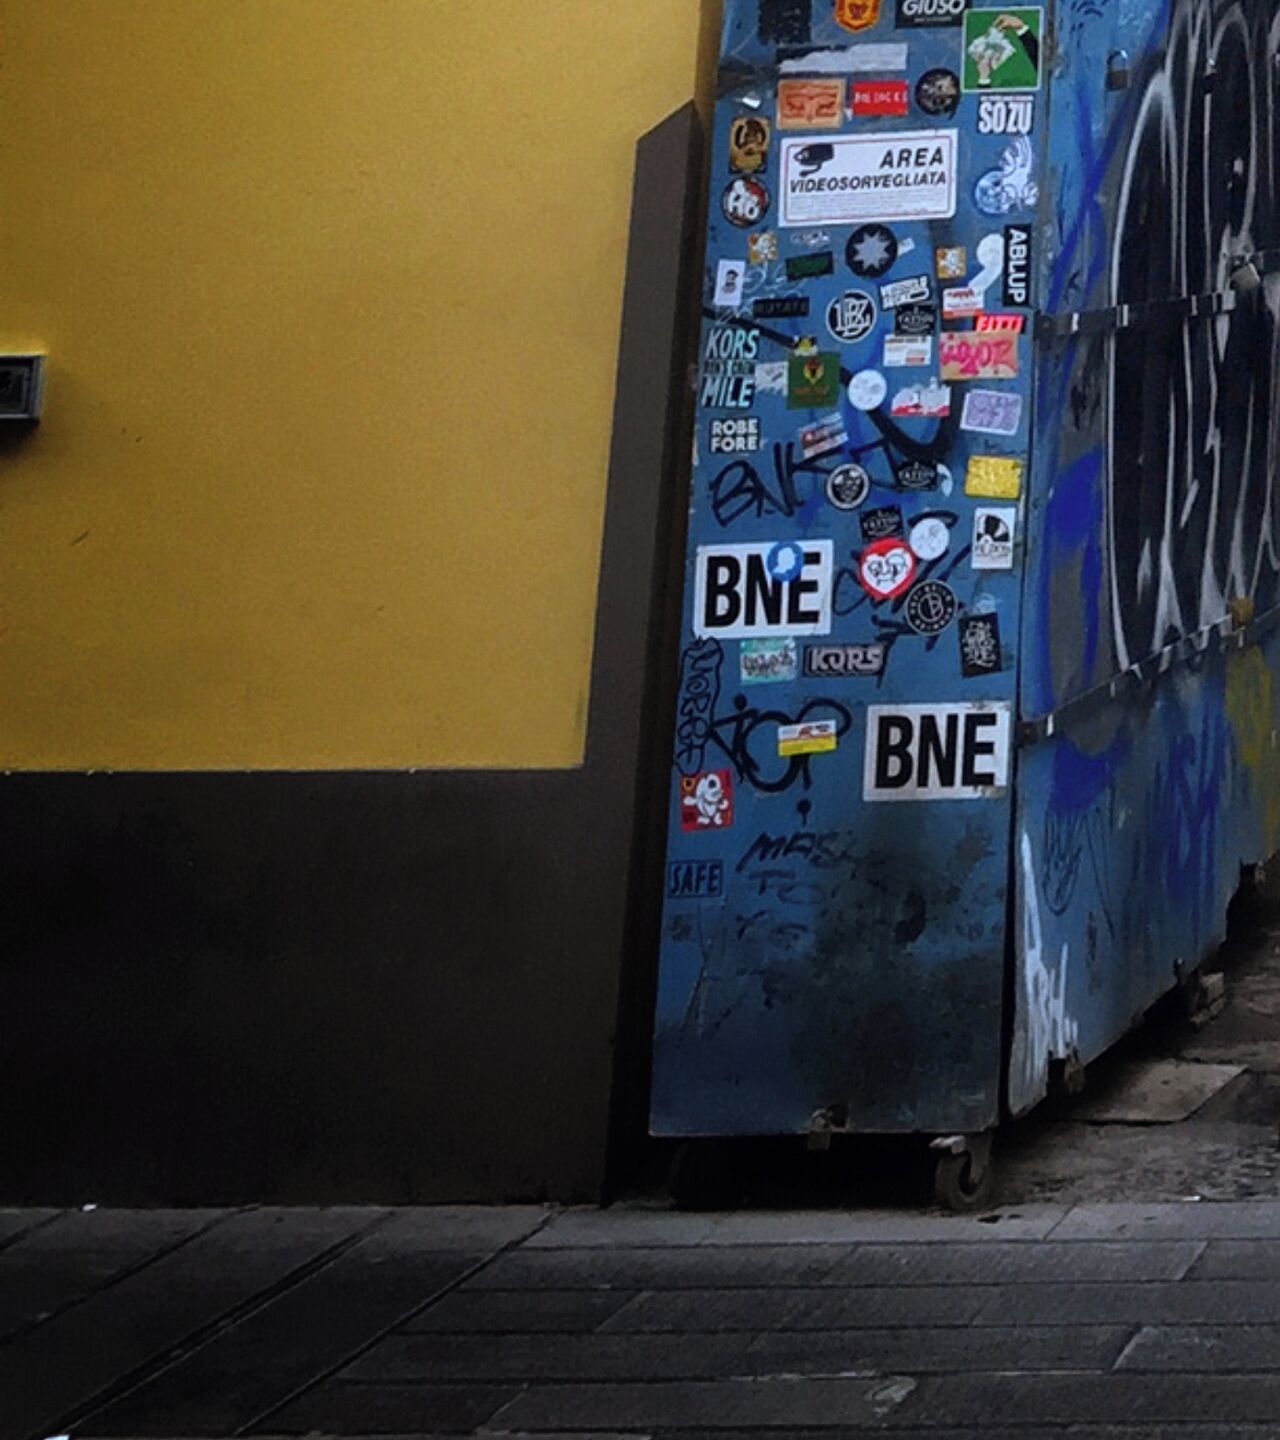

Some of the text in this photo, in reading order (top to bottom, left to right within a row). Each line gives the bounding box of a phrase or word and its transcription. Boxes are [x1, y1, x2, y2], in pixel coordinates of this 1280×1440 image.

[978, 101, 1034, 134] SOZU
[879, 147, 945, 171] AREA
[789, 171, 947, 194] VIDEOSORVEGLIATA
[1007, 228, 1030, 306] ABLUP
[706, 327, 760, 360] KORS
[701, 377, 755, 409] MILE
[712, 418, 759, 436] ROBE
[710, 436, 758, 454] FORE
[705, 551, 822, 629] BNE
[874, 713, 998, 790] BNE
